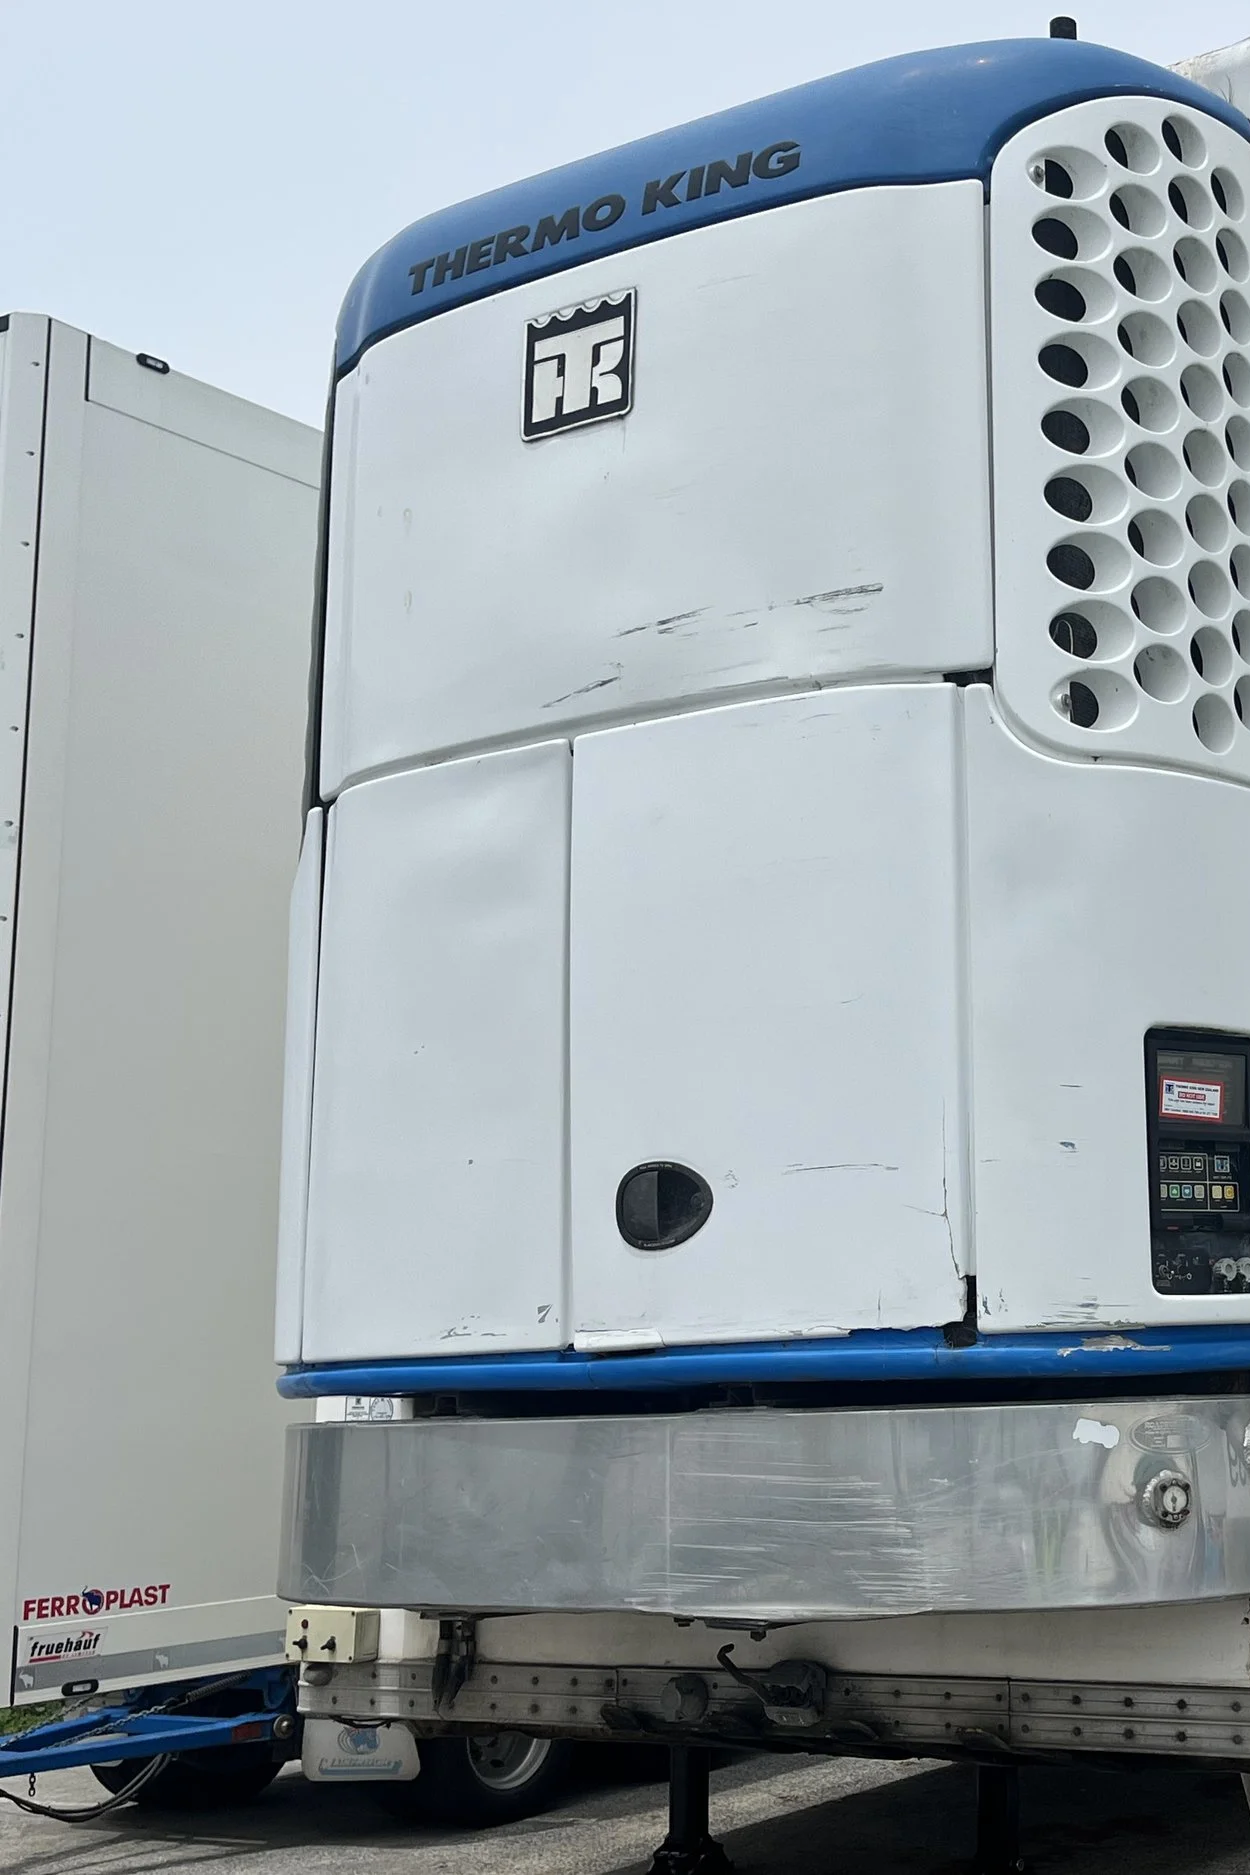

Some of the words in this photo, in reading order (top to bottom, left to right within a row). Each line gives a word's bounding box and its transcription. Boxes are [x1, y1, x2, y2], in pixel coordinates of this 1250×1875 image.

[408, 193, 626, 296] THERMO
[640, 141, 801, 215] KING
[23, 1584, 171, 1621] FERROPLAST
[30, 1634, 101, 1657] fruehauf
